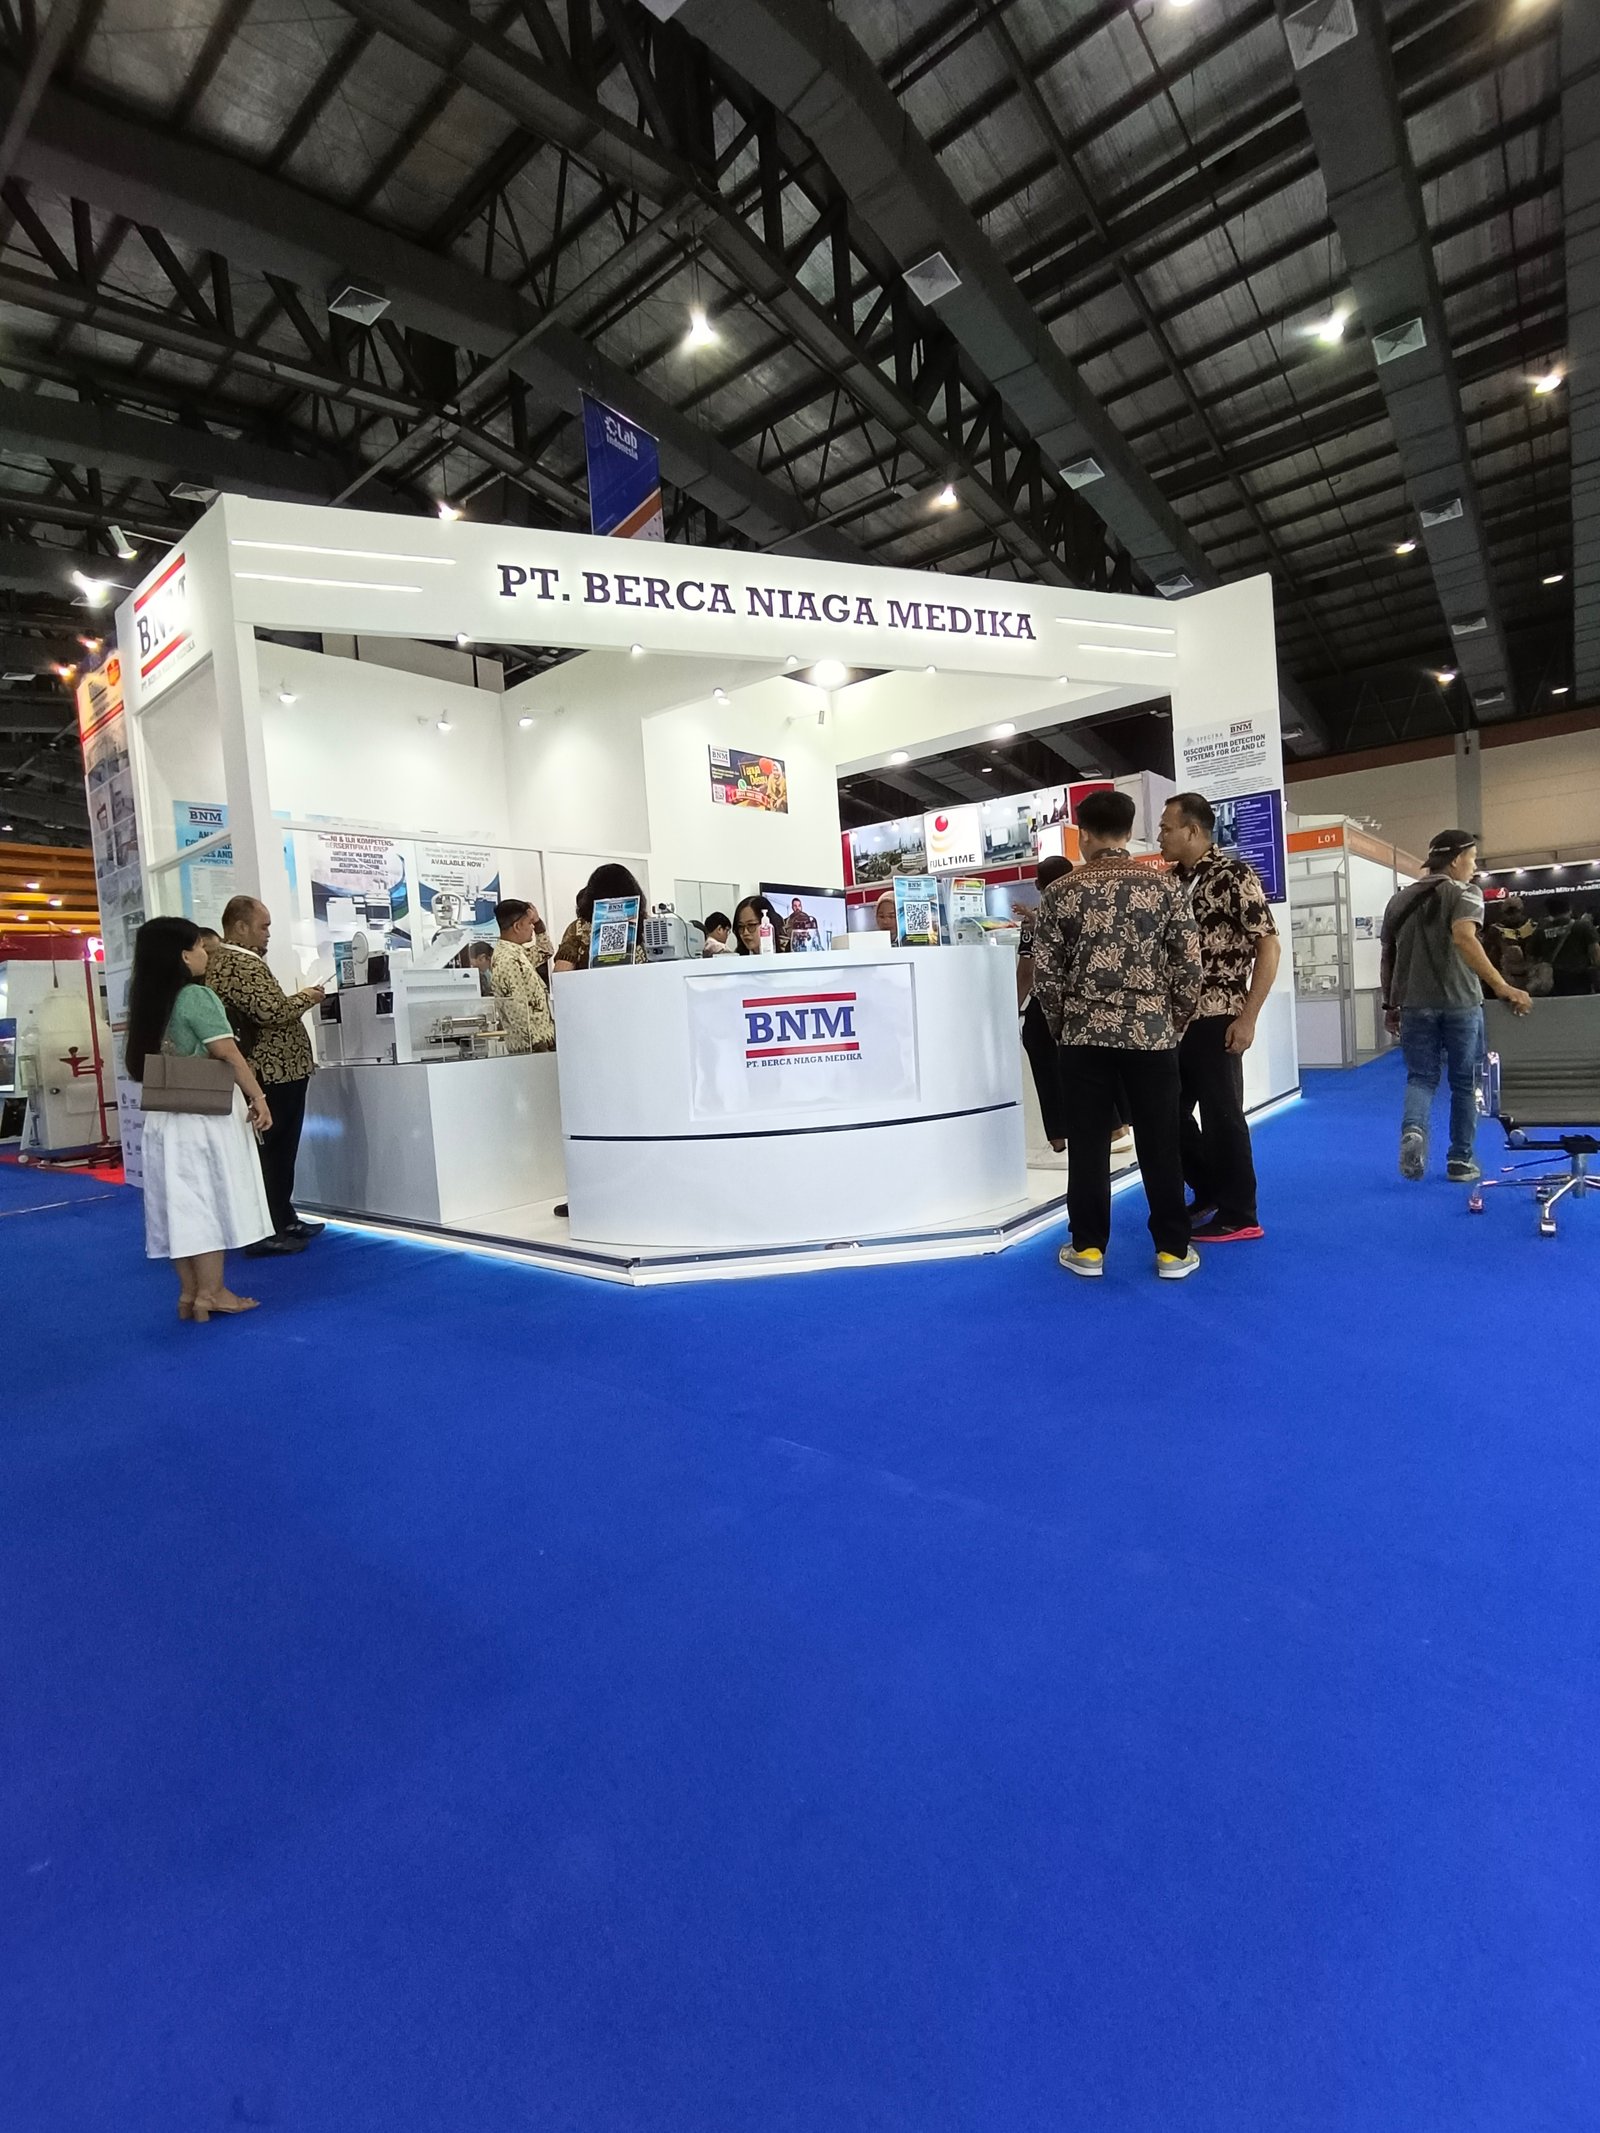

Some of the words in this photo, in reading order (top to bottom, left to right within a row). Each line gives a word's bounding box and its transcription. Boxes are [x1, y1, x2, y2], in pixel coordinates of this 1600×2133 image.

[497, 564, 570, 601] PT.
[582, 572, 736, 614] BERCA
[745, 586, 878, 626] NIAGA
[887, 600, 1037, 640] MEDIKA
[1230, 722, 1252, 733] BNM
[1183, 744, 1214, 757] DISCOVIR
[1214, 741, 1229, 750] FTIR
[1229, 733, 1266, 747] DETECTION
[1185, 751, 1215, 763] SYSTEMS
[1216, 748, 1230, 756] FOR
[1241, 742, 1255, 752] AND
[1256, 740, 1266, 748] LC
[712, 750, 728, 761] BNM
[189, 810, 222, 822] BNM
[1317, 834, 1336, 844] L01
[431, 858, 466, 867] AVAILABLE
[930, 854, 976, 868] FULLTIME
[745, 1006, 856, 1044] BNM
[746, 1060, 759, 1068] PT.
[761, 1058, 792, 1067] BERCA
[794, 1055, 823, 1065] NIAGA
[825, 1053, 863, 1062] MEDIKA
